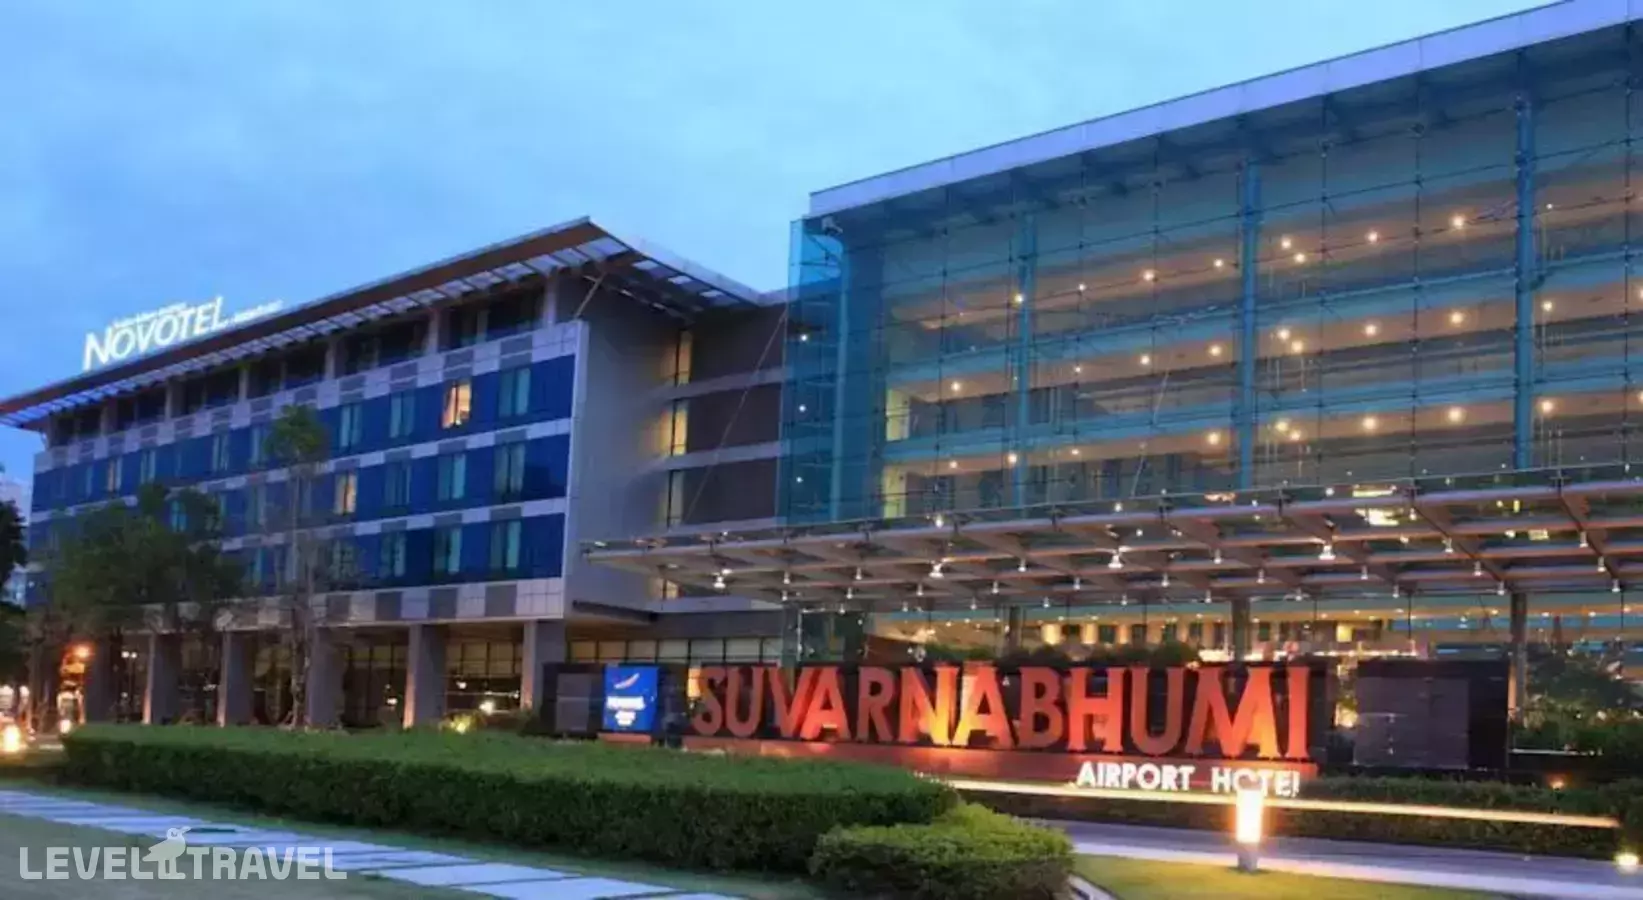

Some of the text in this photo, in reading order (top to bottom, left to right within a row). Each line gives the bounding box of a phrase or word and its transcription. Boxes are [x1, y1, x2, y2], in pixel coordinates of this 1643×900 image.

[82, 296, 225, 371] NOVOTEL
[691, 662, 1310, 760] SUVARNABHUMI
[1076, 761, 1195, 791] AIRPORT
